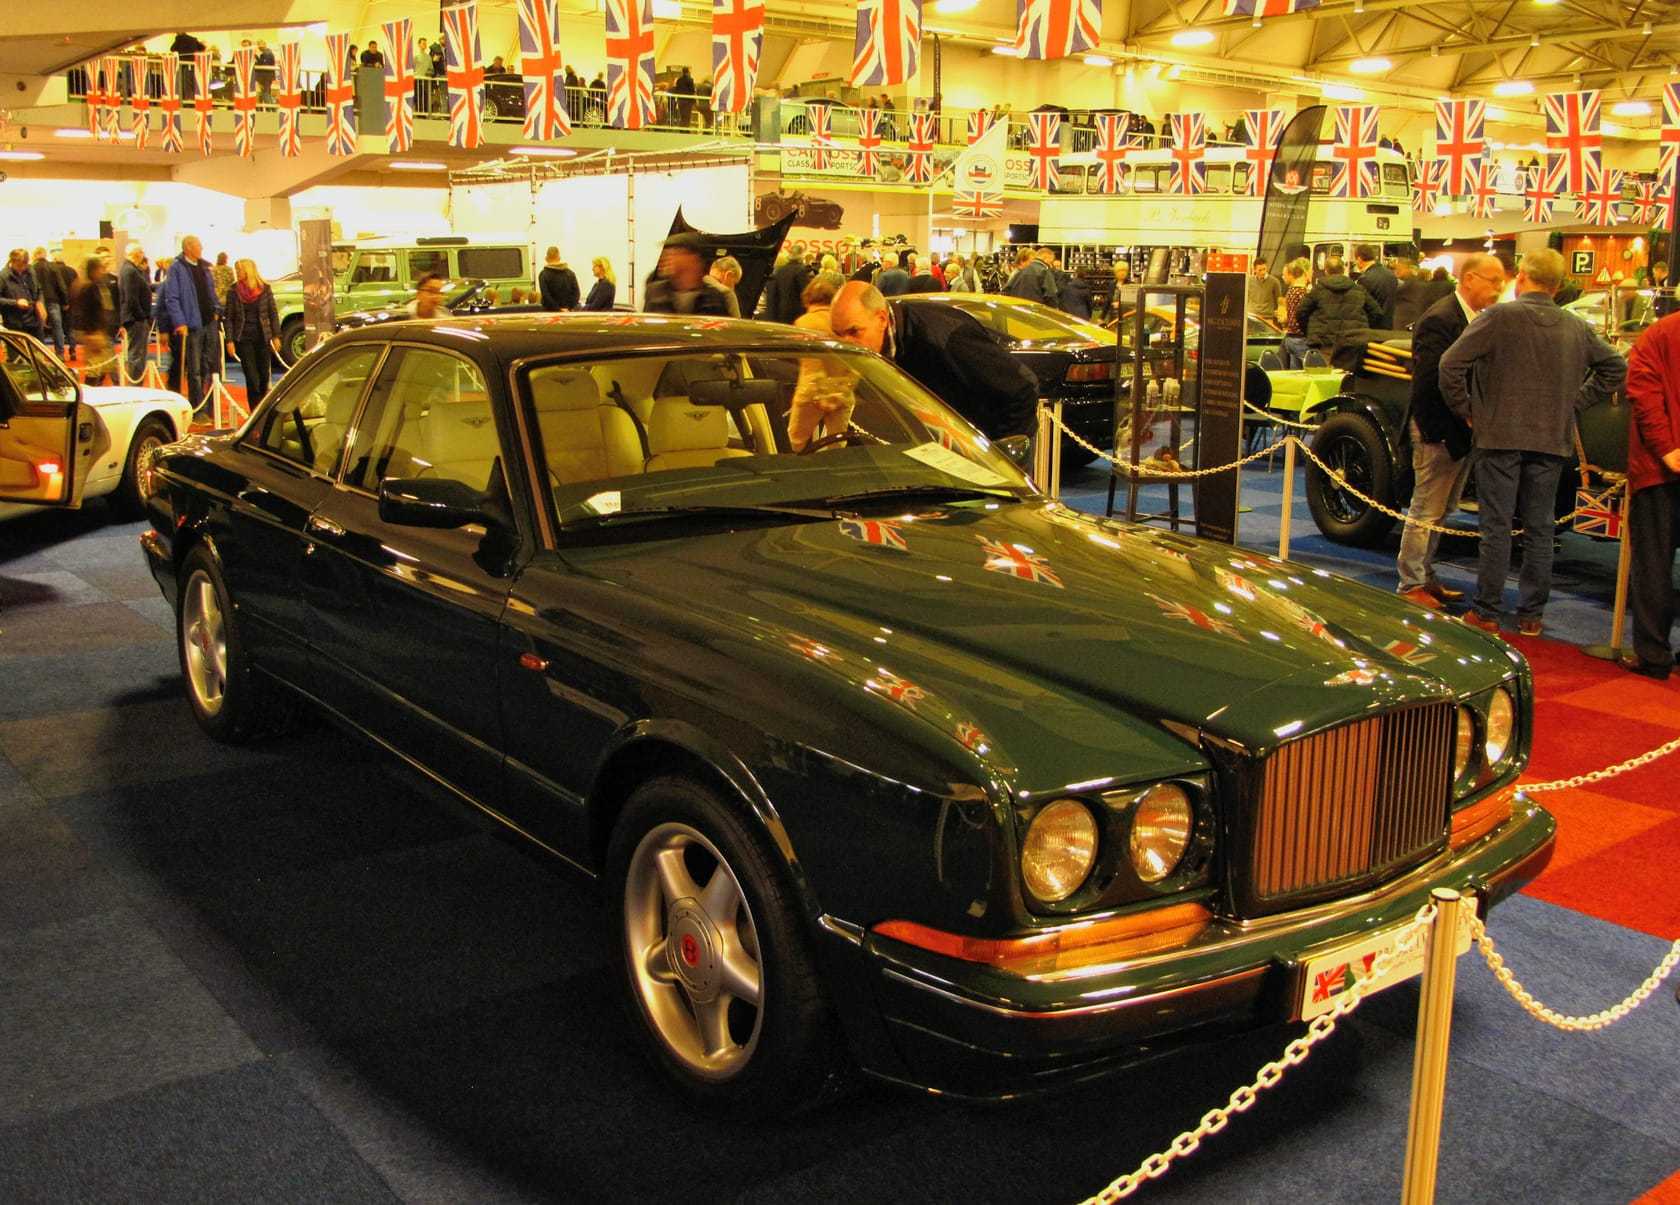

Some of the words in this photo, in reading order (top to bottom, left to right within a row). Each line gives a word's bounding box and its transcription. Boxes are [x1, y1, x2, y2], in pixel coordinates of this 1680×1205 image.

[787, 148, 862, 160] CAOSS
[783, 239, 849, 254] ROSSO
[1576, 253, 1590, 272] P
